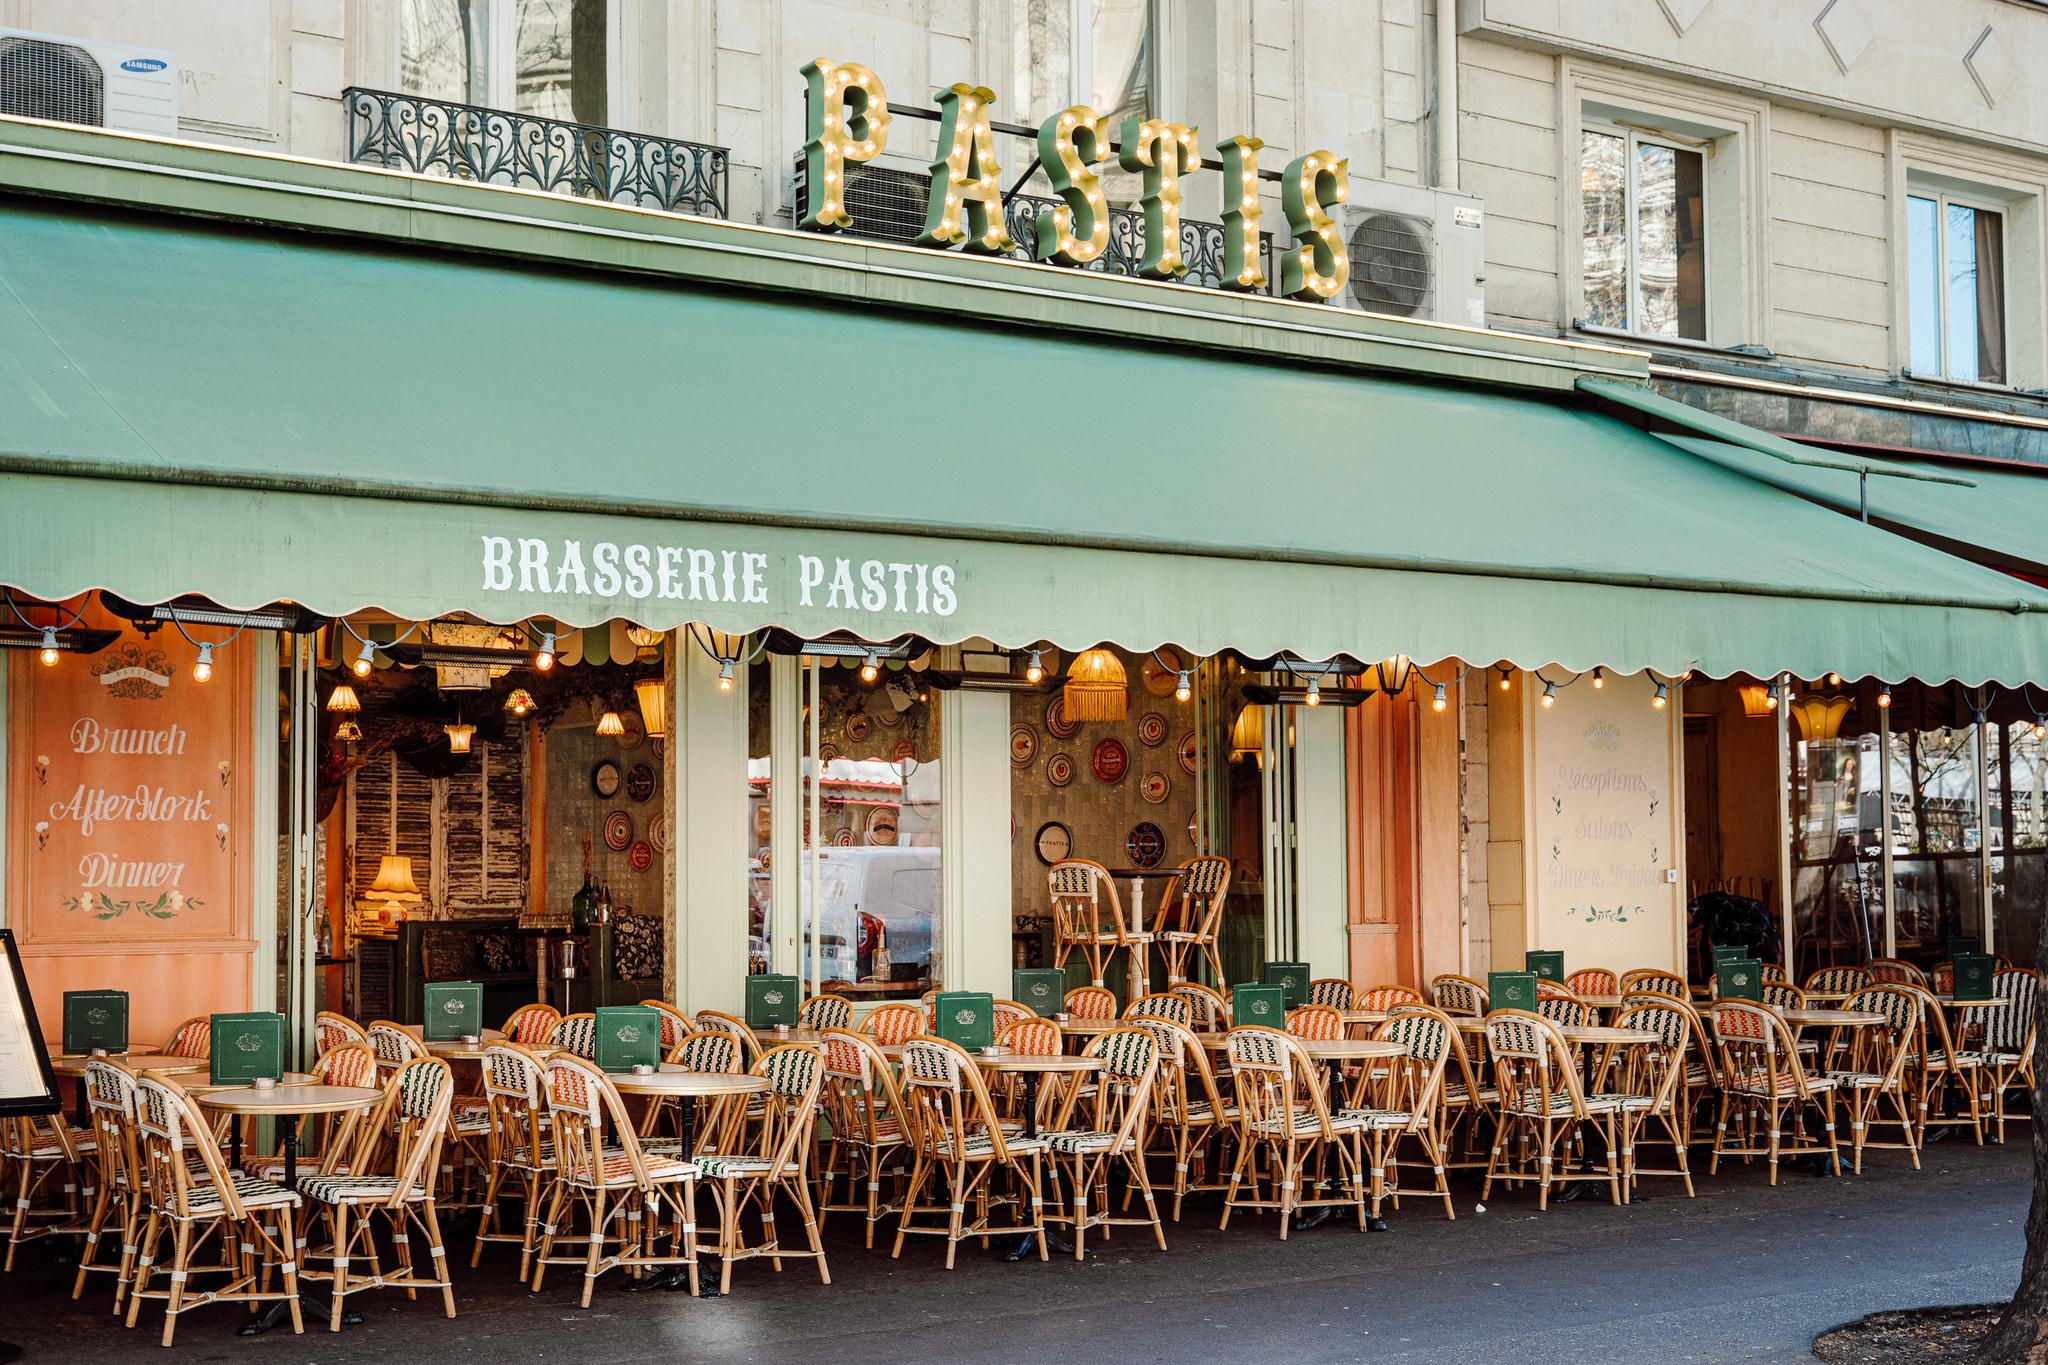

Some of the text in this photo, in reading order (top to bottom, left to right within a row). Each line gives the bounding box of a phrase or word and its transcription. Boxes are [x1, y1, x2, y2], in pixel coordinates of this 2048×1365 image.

[126, 60, 162, 72] SAMSUNG
[800, 57, 1350, 300] PASTIS
[481, 535, 957, 616] BRASSERIE PASTIS
[70, 717, 187, 755] Brunch
[1575, 813, 1633, 841] Salons
[79, 852, 186, 888] Dinner
